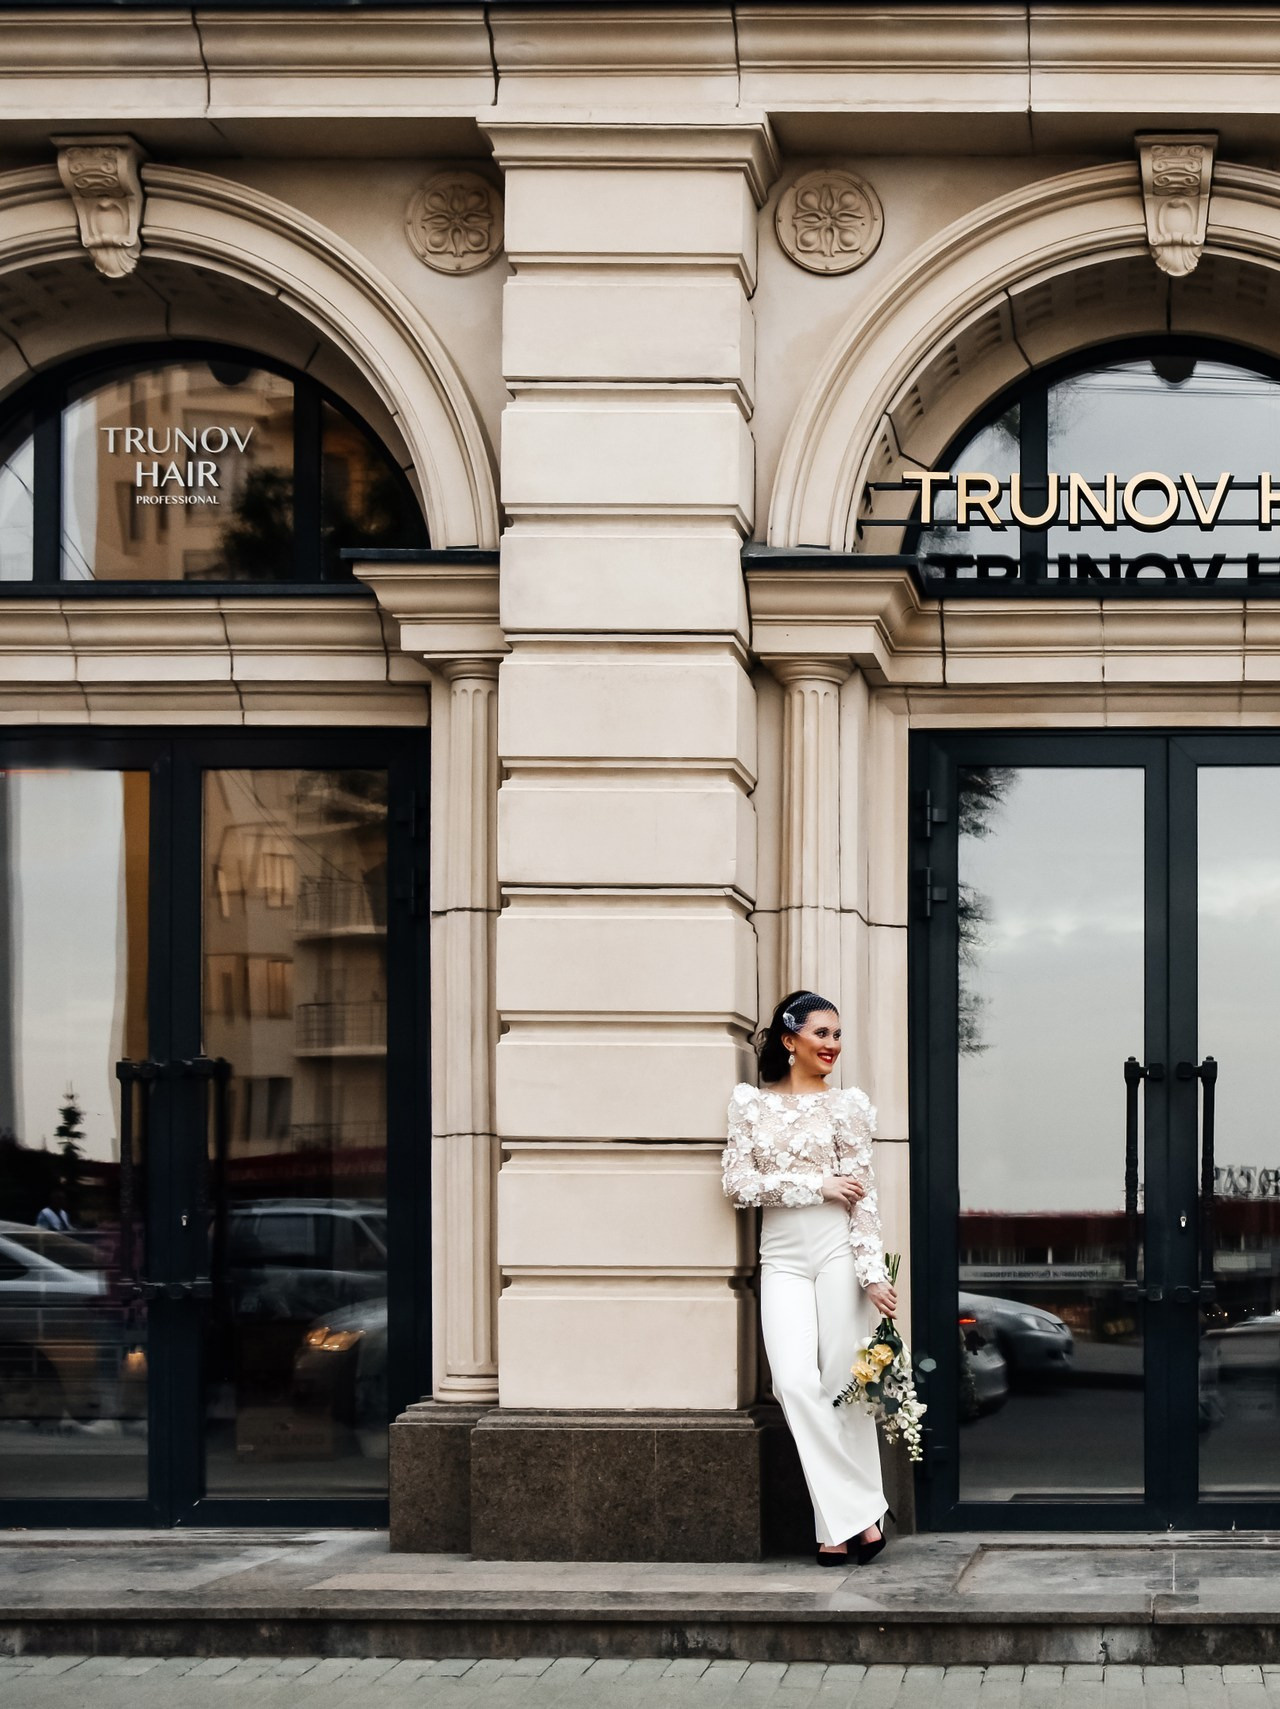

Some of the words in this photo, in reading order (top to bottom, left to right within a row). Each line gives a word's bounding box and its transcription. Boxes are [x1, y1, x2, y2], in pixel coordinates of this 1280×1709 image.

[100, 426, 254, 454] TRUNOV
[136, 460, 220, 488] HAIR
[136, 495, 220, 505] PROFESSIONAL
[902, 471, 1232, 528] TRUNOV
